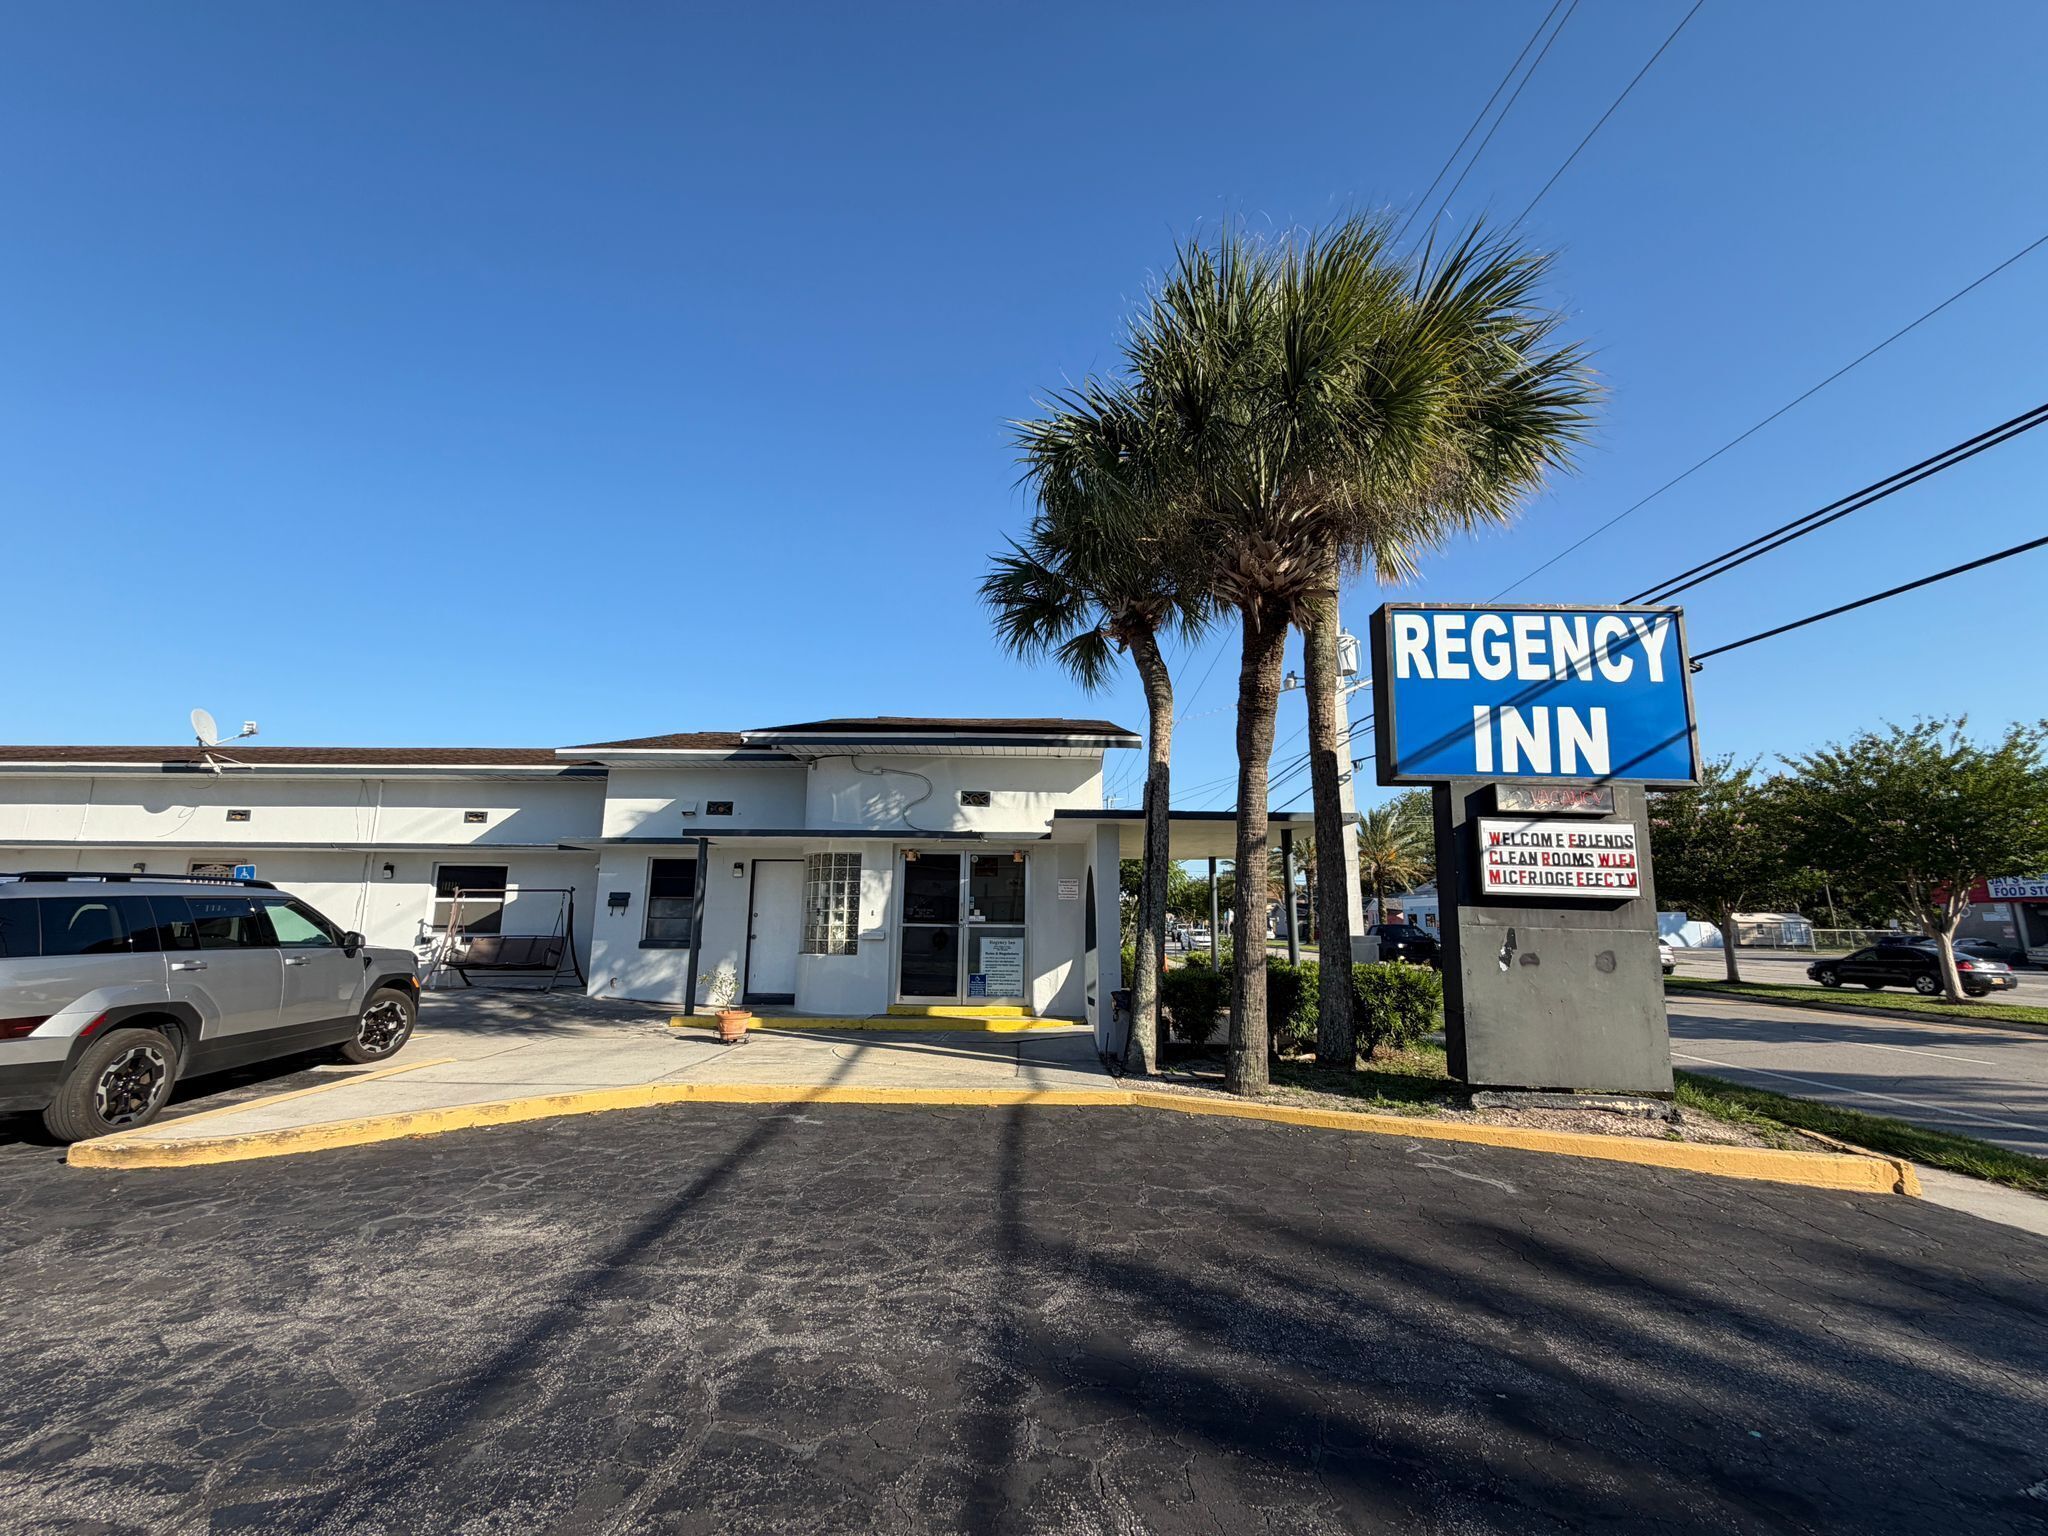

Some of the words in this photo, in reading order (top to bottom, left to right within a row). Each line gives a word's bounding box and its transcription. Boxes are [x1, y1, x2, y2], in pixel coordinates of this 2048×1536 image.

[1394, 614, 1670, 682] REGENCY
[1473, 705, 1610, 775] INN
[1530, 789, 1604, 806] VACANCY
[1489, 832, 1564, 848] WELCOME
[1489, 850, 1538, 866] CLEAN
[1541, 852, 1595, 868] ROOMS
[1489, 869, 1574, 886] MICFRIDGE
[1994, 887, 2026, 896] FOOD
